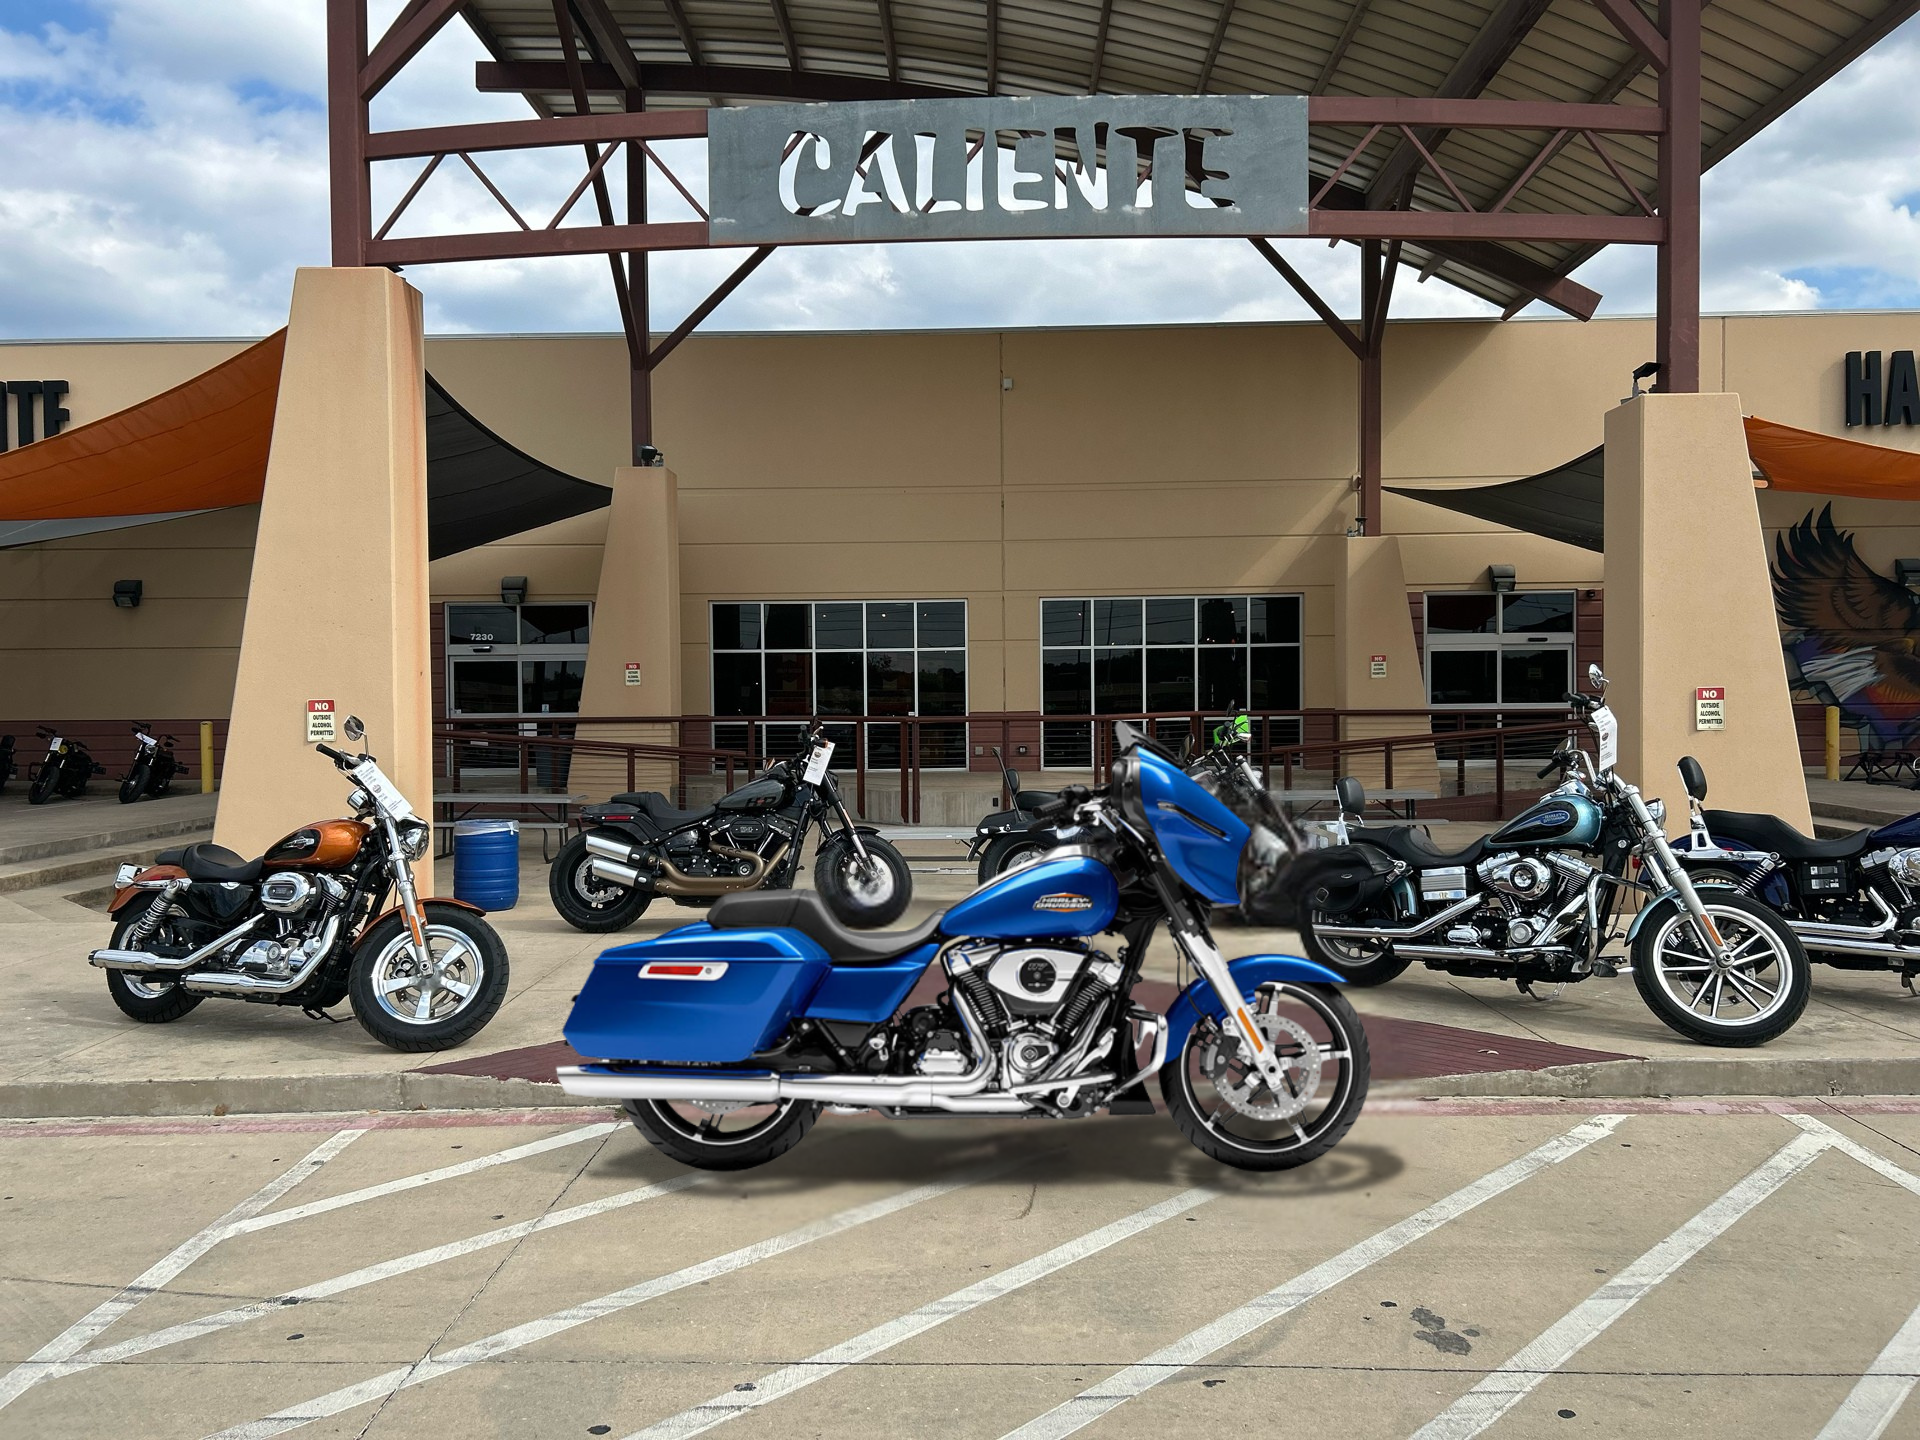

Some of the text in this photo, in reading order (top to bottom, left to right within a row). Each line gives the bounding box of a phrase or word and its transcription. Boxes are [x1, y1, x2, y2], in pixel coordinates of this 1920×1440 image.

[778, 121, 1235, 217] CALIENTE
[1845, 350, 1920, 427] HA
[470, 633, 494, 641] 7230
[1702, 690, 1717, 698] NO
[314, 702, 329, 710] NO
